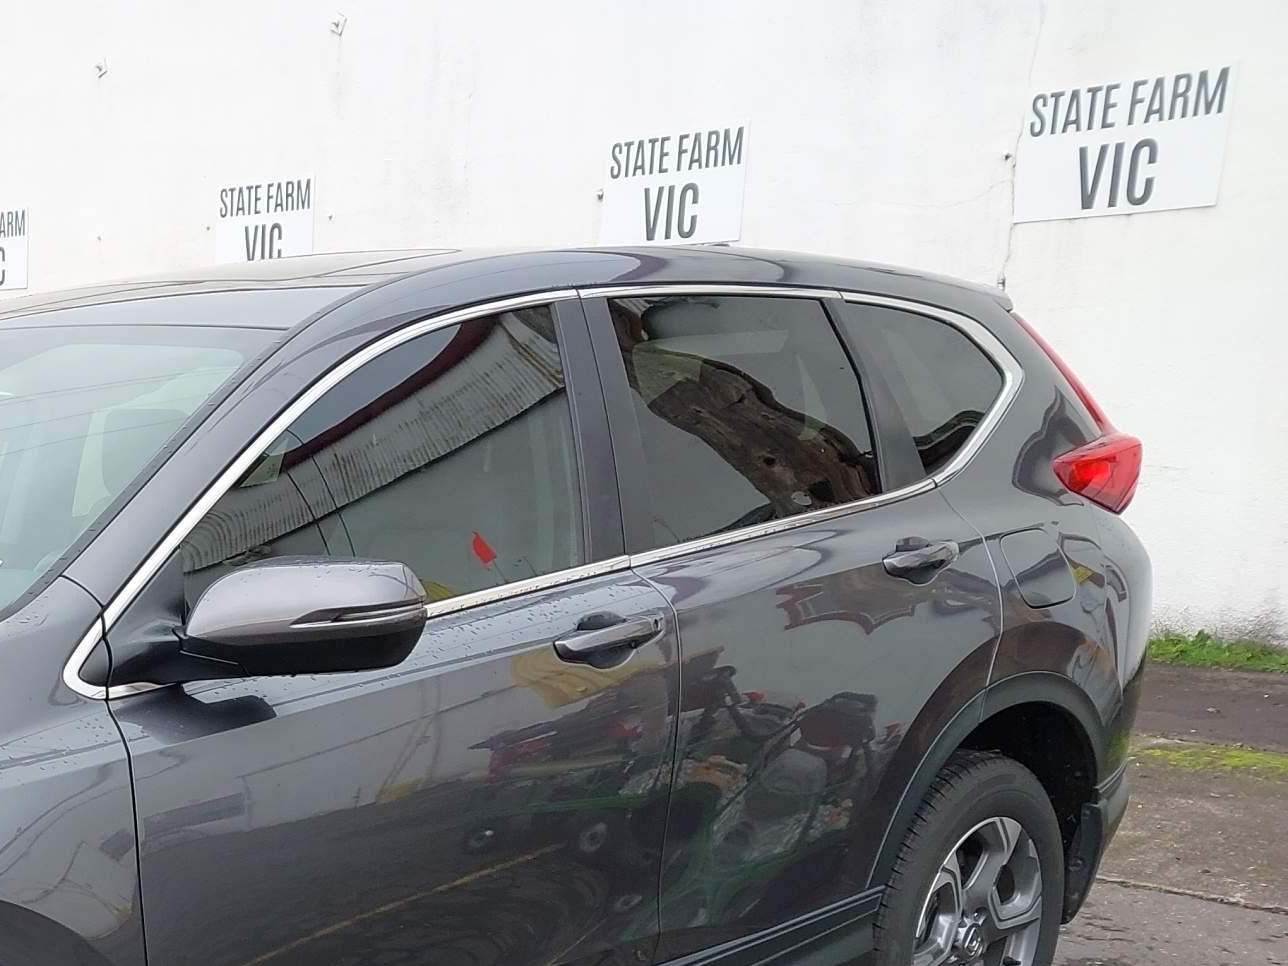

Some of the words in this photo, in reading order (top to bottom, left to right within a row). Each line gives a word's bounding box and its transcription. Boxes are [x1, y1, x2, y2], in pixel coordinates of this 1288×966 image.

[1030, 83, 1121, 137] STATE
[1127, 66, 1231, 126] FARM
[610, 136, 671, 179] STATE
[676, 126, 744, 172] FARM
[1078, 138, 1159, 210] VIC
[219, 184, 262, 218] STATE
[266, 178, 311, 214] FARM
[644, 182, 699, 241] VIC
[244, 222, 282, 261] VIC
